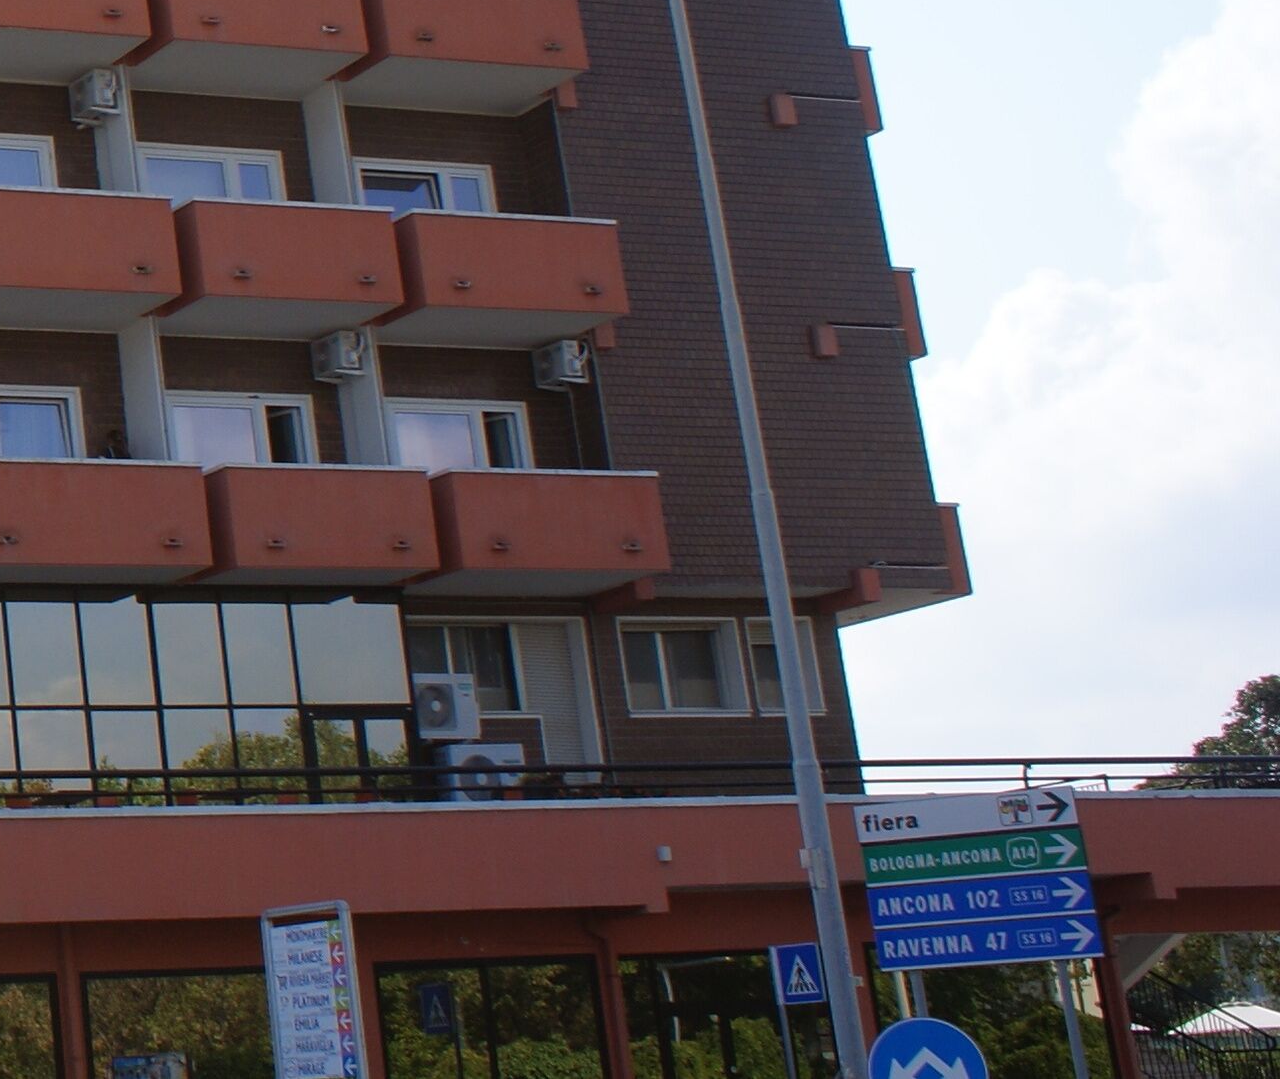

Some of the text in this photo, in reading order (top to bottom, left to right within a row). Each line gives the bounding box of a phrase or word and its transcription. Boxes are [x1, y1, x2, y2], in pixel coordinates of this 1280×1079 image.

[862, 814, 919, 832] fiera
[869, 845, 1036, 872] BOLOGNA-ANCONA A14
[877, 889, 1000, 916] ANCONA 102
[883, 931, 1008, 959] RAVENNA 47
[292, 995, 330, 1010] PLATINUM
